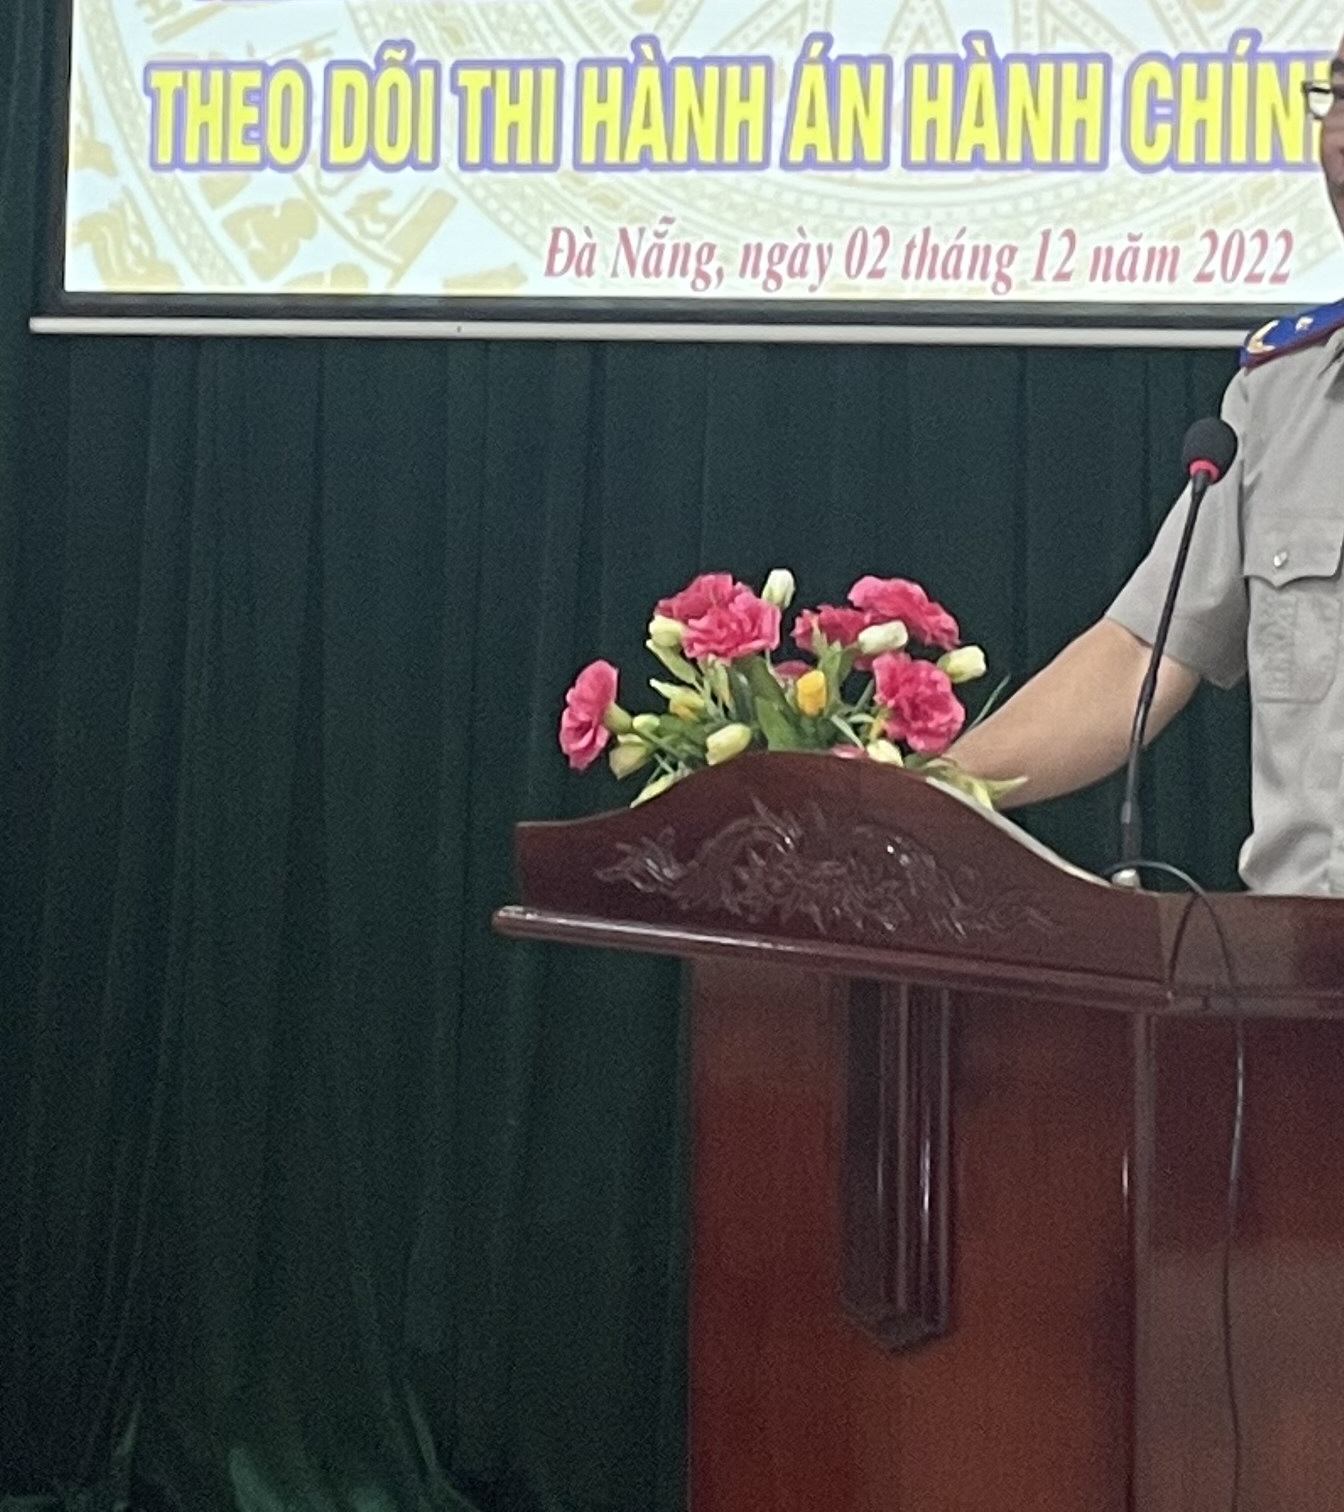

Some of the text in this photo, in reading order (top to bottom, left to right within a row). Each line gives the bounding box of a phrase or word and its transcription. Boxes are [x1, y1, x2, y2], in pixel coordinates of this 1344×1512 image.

[144, 60, 311, 172] THEO
[320, 39, 441, 172] DÕI
[455, 60, 564, 172] THI
[572, 35, 773, 172] HÀNH
[780, 30, 892, 172] ÁN
[902, 30, 1112, 172] HÀNH
[544, 216, 1295, 296] Đà Nẵng, ngày 02 tháng 12 năm 2022
